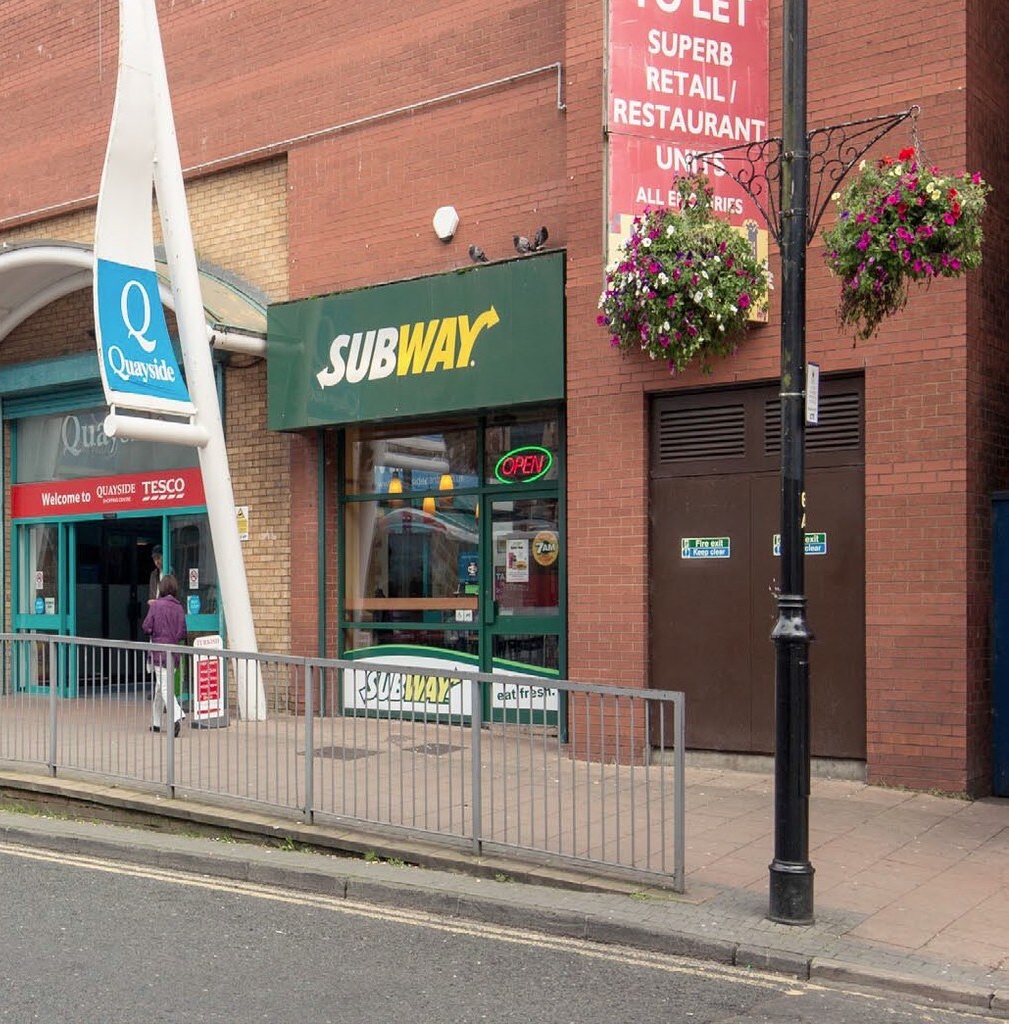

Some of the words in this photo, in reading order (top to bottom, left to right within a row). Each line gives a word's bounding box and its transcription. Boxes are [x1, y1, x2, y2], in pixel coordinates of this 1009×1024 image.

[647, 29, 733, 67] SUPERB
[646, 66, 725, 103] RETAIL
[613, 99, 766, 143] RESTAURANT
[656, 145, 726, 177] UNITS
[636, 187, 664, 206] ALL
[121, 280, 156, 353] Q
[316, 305, 500, 390] SUBWAY
[108, 345, 175, 382] Quayside
[502, 455, 543, 475] OPEN
[96, 483, 136, 497] QUAYSIDE
[142, 478, 185, 495] TESCO
[41, 492, 80, 506] Welcome
[81, 491, 91, 504] to
[535, 542, 556, 554] 7AM
[695, 539, 709, 548] Fire
[710, 538, 724, 547] exit
[805, 535, 819, 544] exit
[805, 544, 821, 553] clear
[693, 549, 709, 558] Keep
[710, 548, 725, 556] clear
[359, 671, 461, 704] SUBWAY
[497, 689, 516, 700] eat
